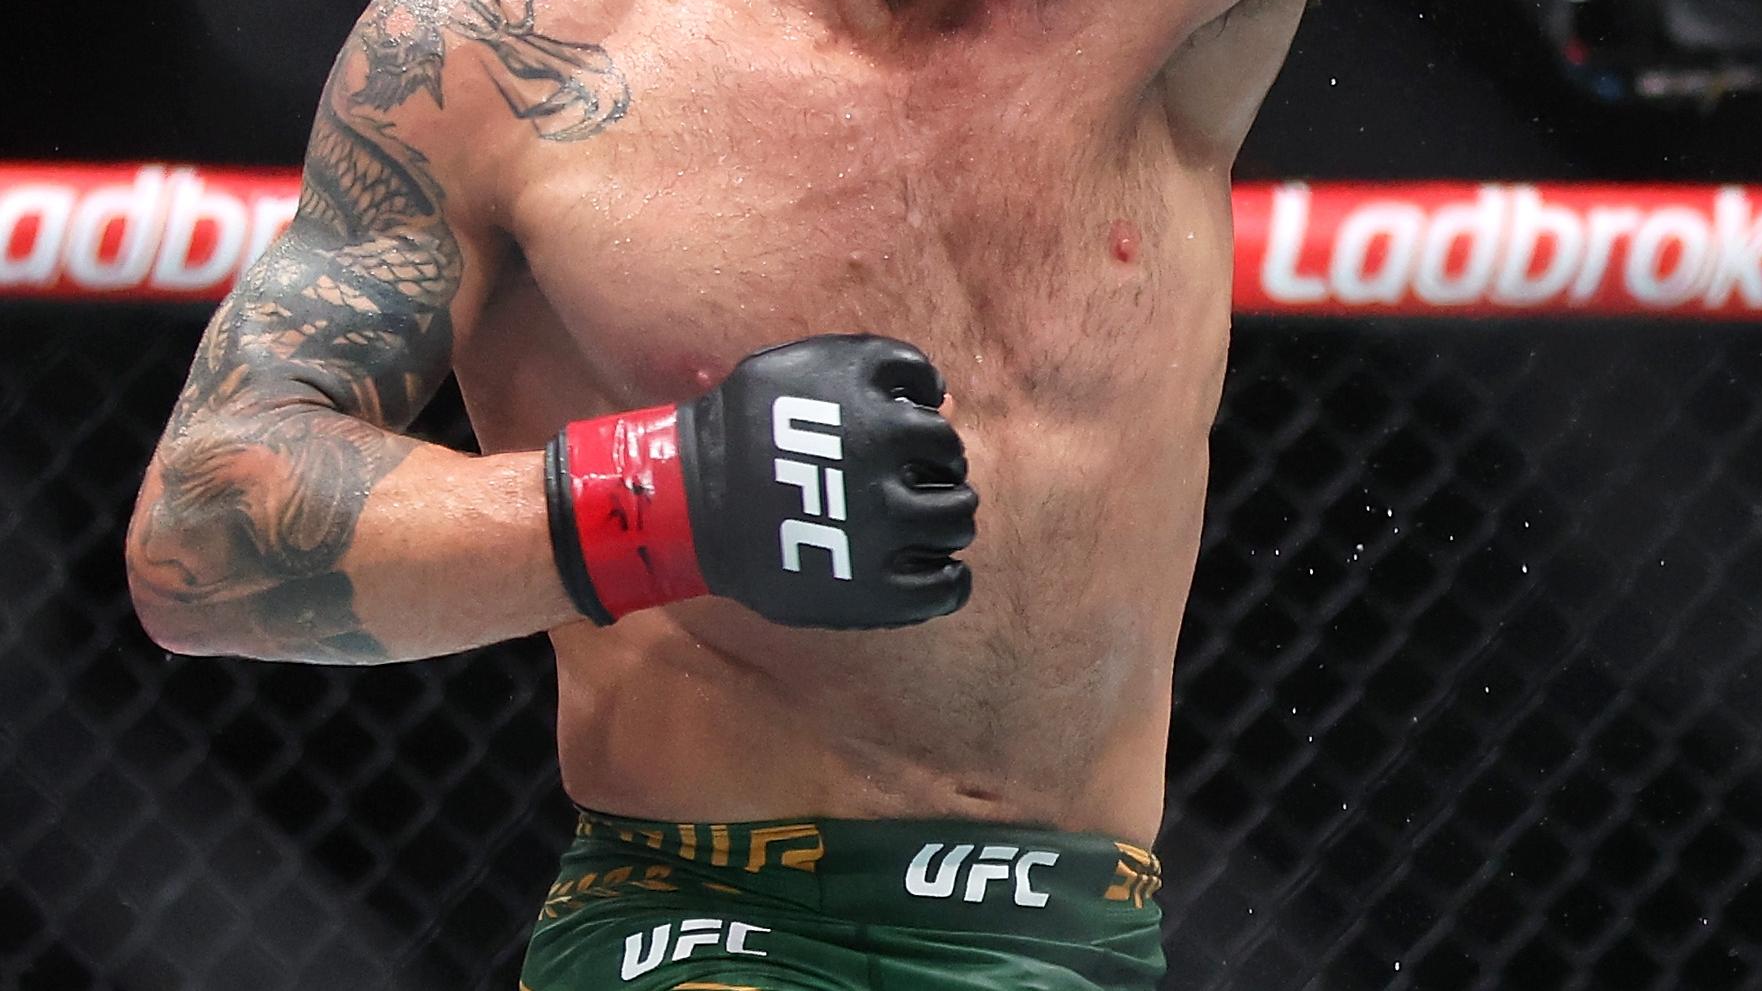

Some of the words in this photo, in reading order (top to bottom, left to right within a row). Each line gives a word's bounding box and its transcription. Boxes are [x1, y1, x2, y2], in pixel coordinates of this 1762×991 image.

[771, 394, 853, 581] UFC
[904, 842, 1061, 909] UFC
[620, 917, 773, 982] UFC
